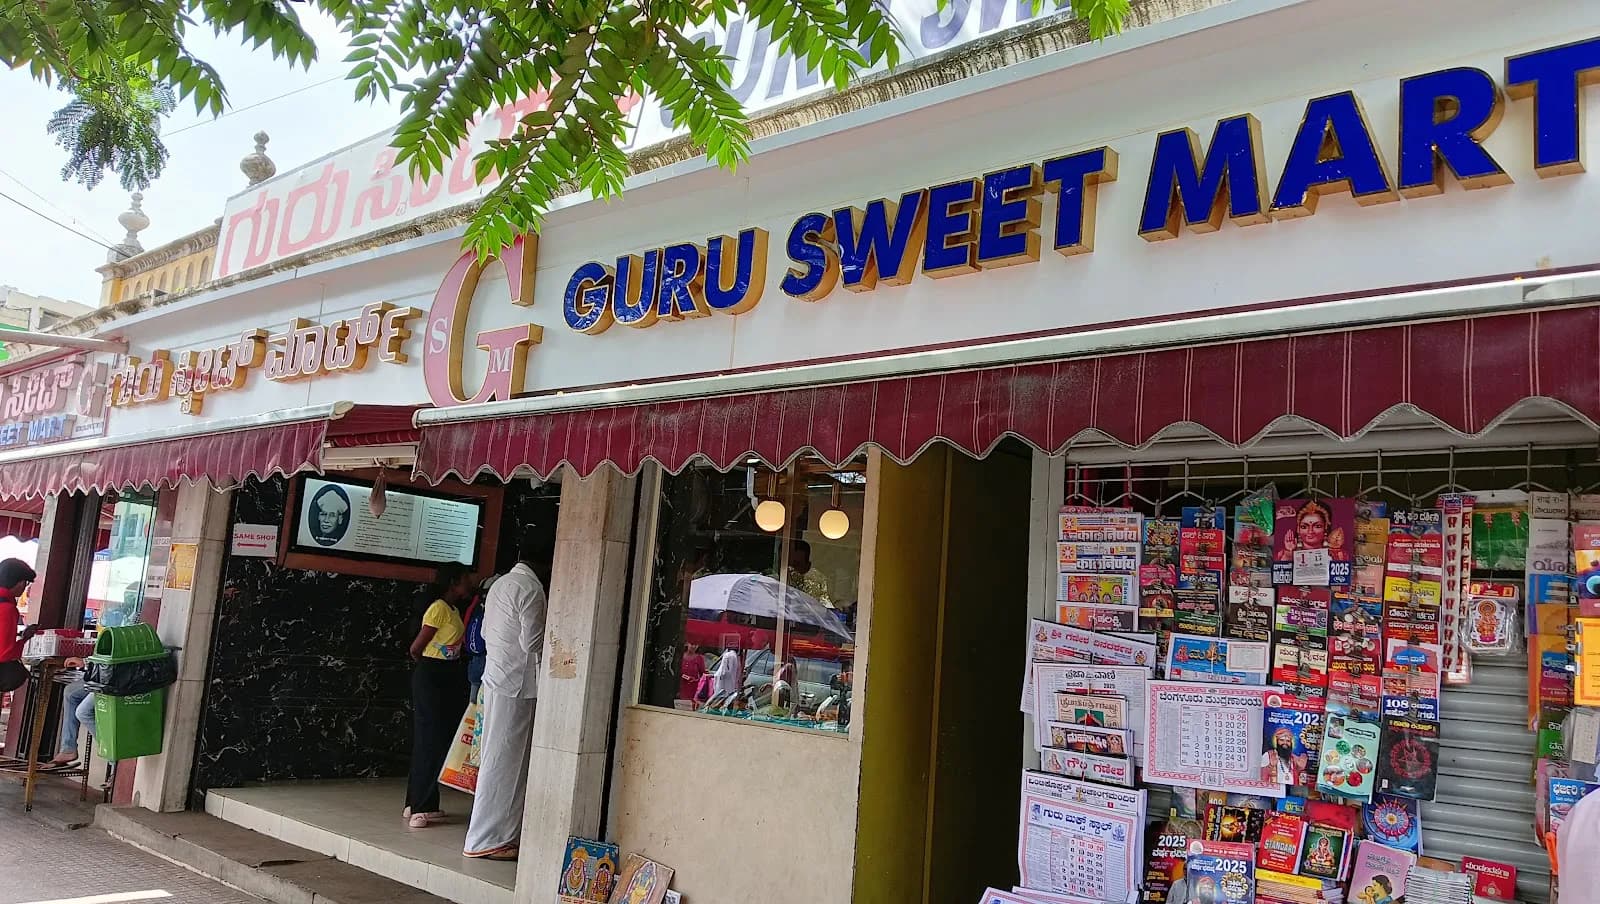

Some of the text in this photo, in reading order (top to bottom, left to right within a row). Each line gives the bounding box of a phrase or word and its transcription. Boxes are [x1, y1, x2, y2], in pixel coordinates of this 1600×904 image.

[562, 37, 1600, 333] GURU SWEET MART
[219, 163, 350, 276] ಗುರು
[424, 232, 531, 407] G
[264, 301, 413, 380] ಮಾರ್ಟ್
[429, 317, 448, 354] S
[490, 347, 512, 373] M
[1330, 563, 1350, 575] 2025
[1160, 692, 1203, 703] ಬೆಂಗಳೂರು
[1386, 699, 1409, 708] 108
[1043, 808, 1063, 821] ಗುರು
[1158, 835, 1186, 847] 2025
[1264, 839, 1297, 856] STANDARD
[1215, 859, 1247, 873] 2025
